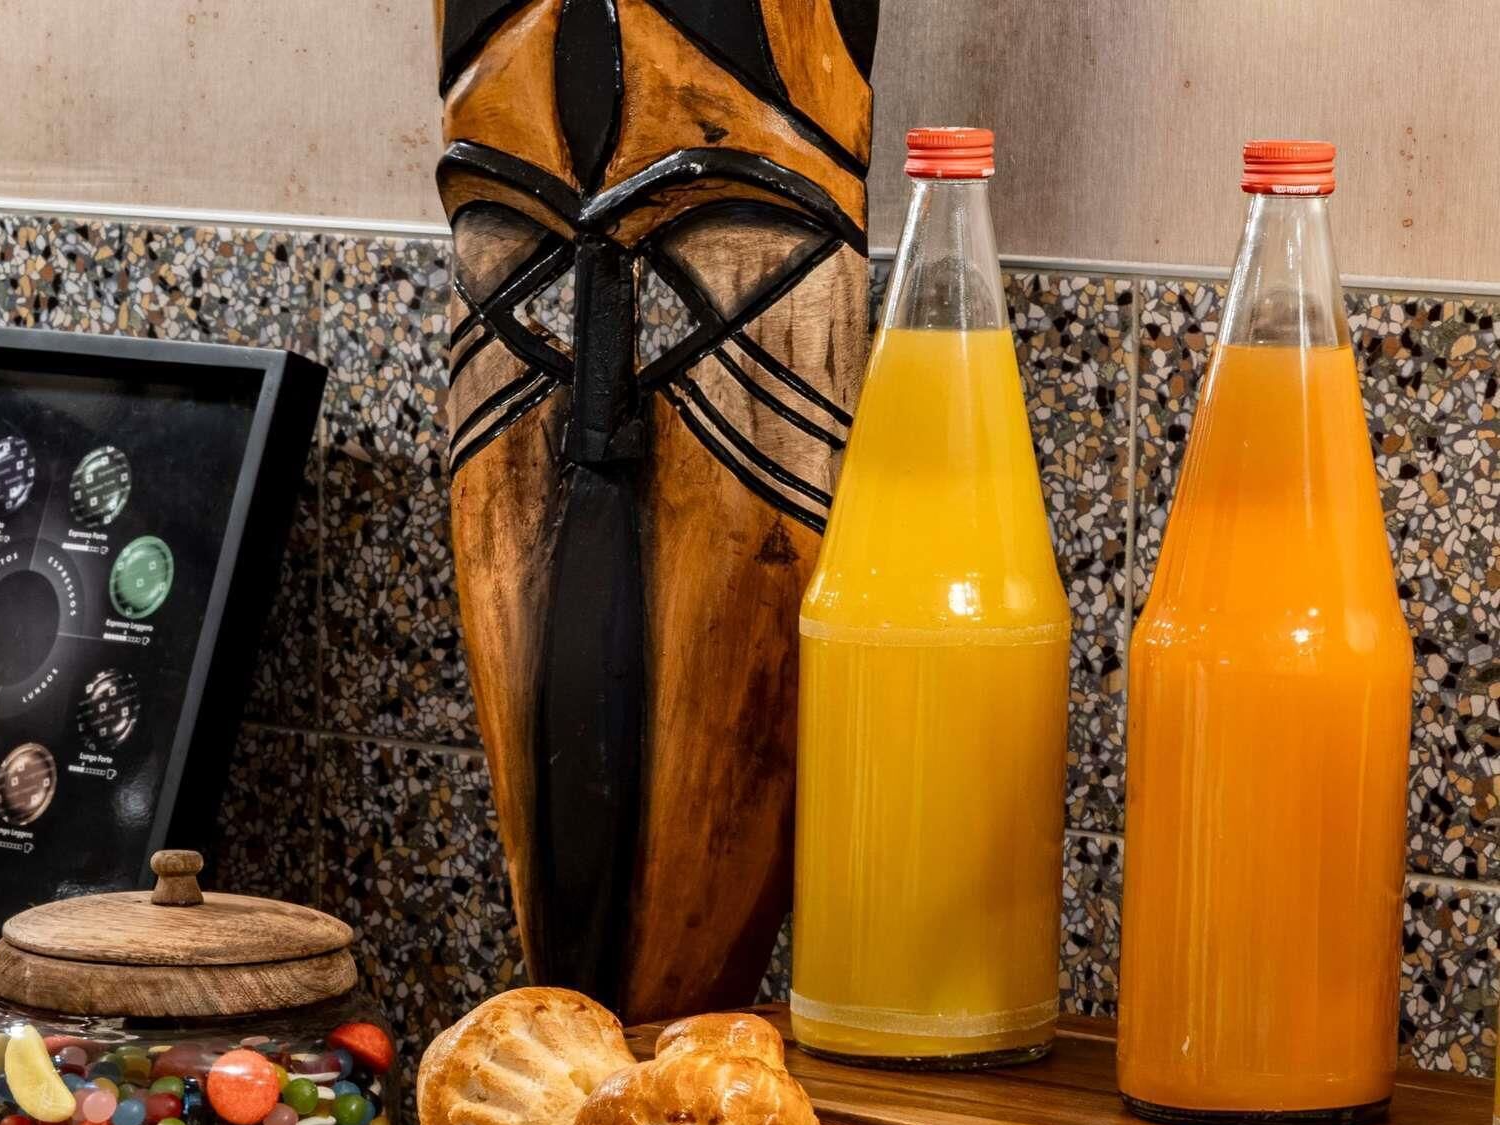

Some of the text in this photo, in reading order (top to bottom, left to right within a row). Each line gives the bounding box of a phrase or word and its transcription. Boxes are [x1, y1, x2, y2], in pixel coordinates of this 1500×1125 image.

[48, 556, 77, 616] ESPRESSOS
[22, 668, 58, 703] LUNGOS
[79, 752, 113, 764] Lungo Forte
[11, 828, 33, 839] Leggero
